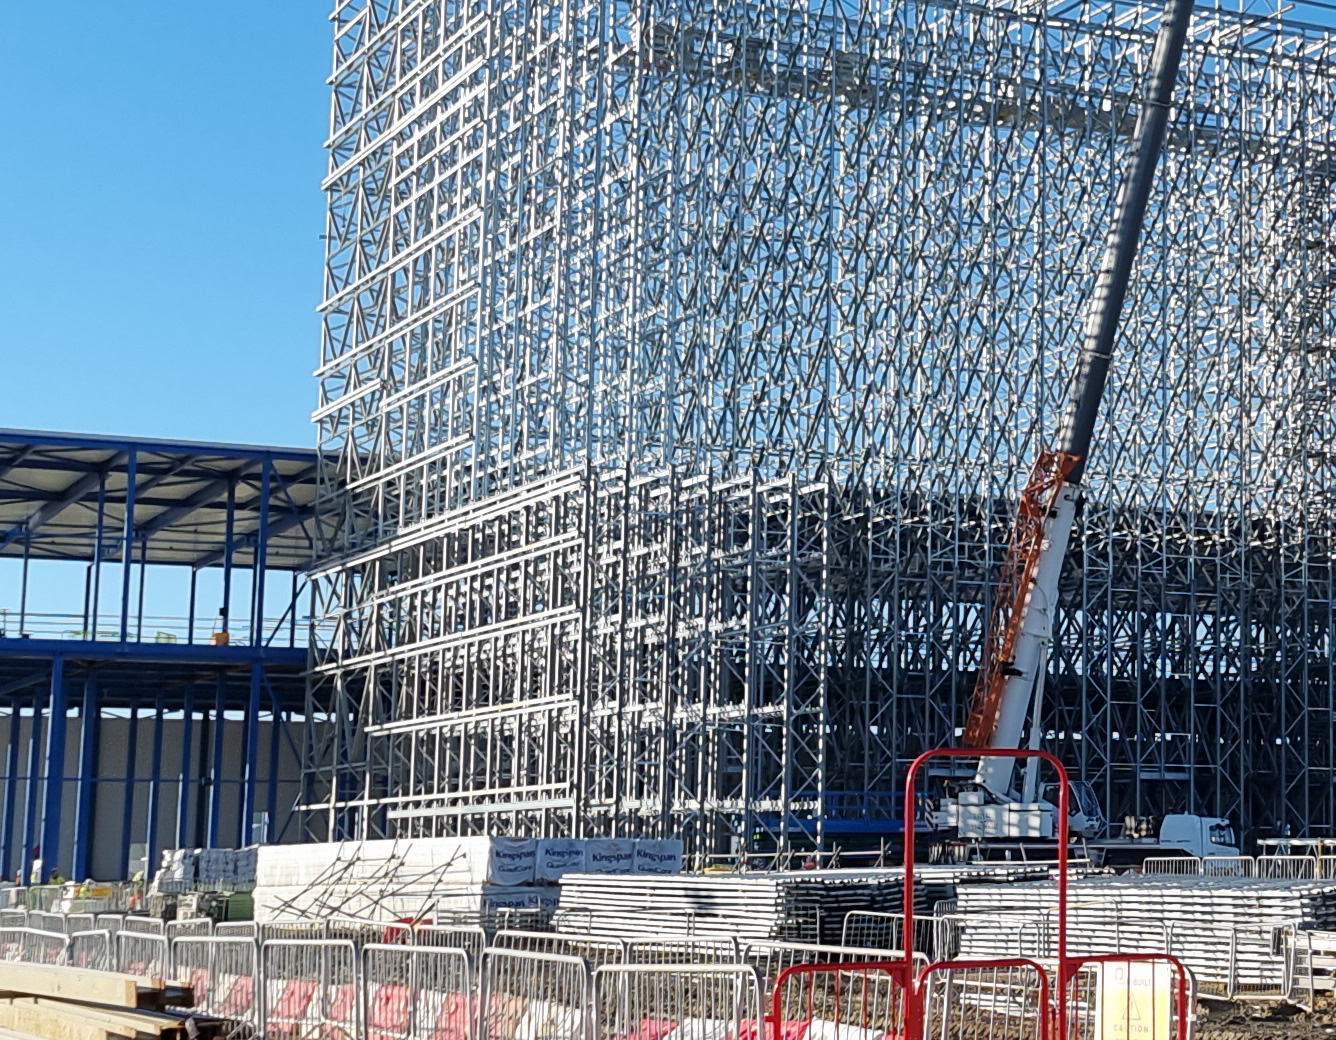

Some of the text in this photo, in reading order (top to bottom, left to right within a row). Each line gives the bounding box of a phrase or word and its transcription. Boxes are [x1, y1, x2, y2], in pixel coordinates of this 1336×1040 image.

[495, 849, 536, 861] Kingspan
[545, 848, 584, 859] Kingspan
[592, 853, 632, 864] Kingspan
[636, 849, 676, 863] Kingspan
[1113, 1024, 1149, 1033] CATION
